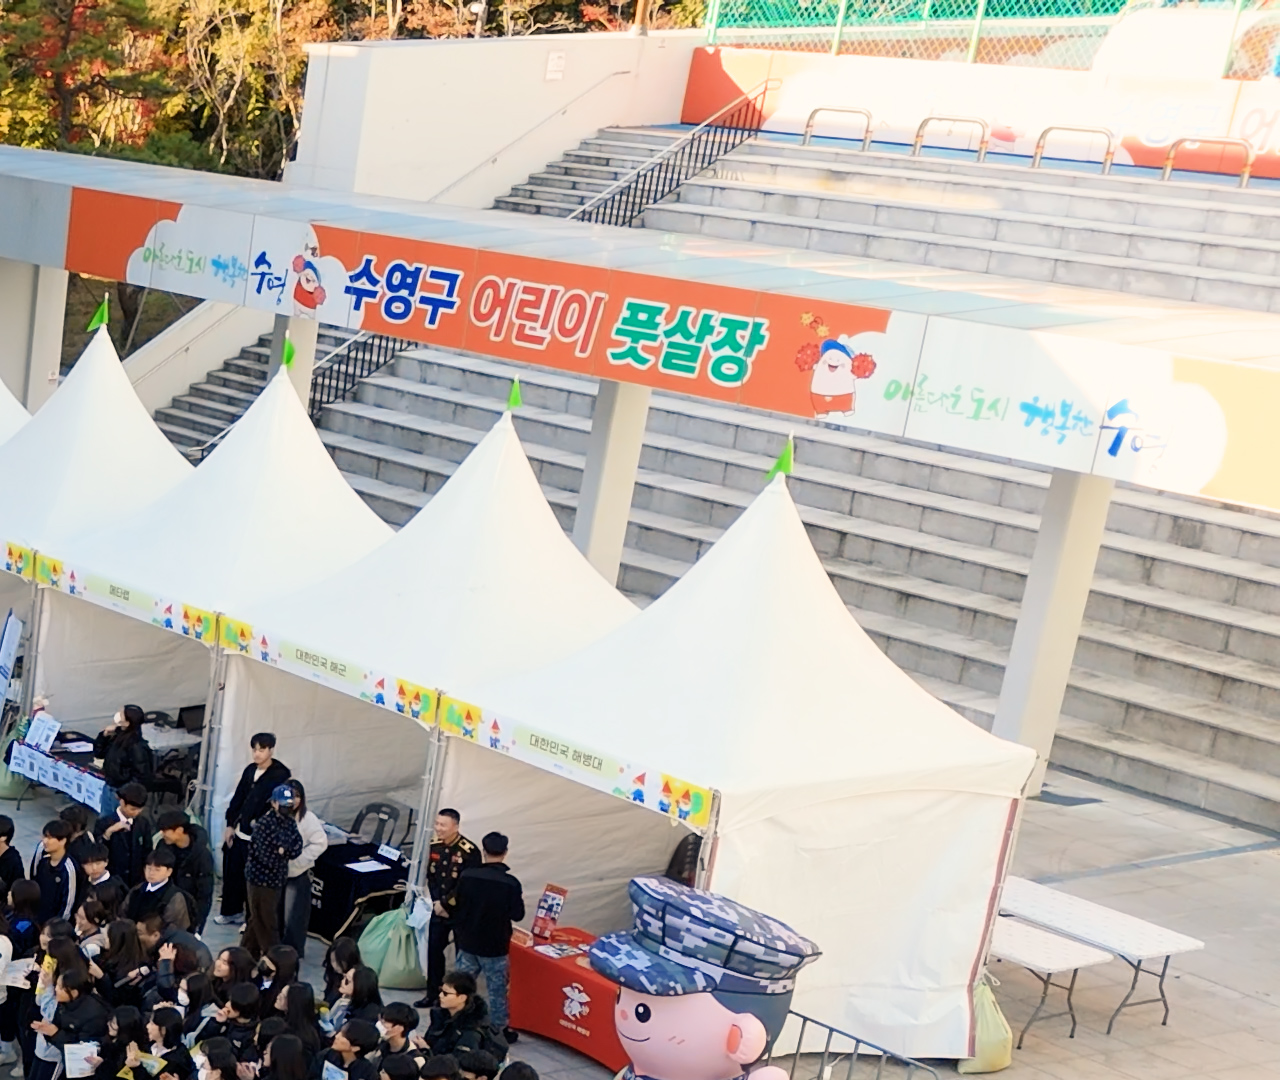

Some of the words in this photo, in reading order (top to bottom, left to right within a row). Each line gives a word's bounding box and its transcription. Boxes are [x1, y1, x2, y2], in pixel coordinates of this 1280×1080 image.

[142, 246, 185, 273] 아름다운
[186, 249, 208, 276] 도시
[211, 254, 247, 288] 행복한
[250, 251, 288, 305] 수영
[344, 256, 462, 328] 수영구
[470, 275, 608, 357] 어린이
[607, 296, 768, 387] 풋살장
[883, 373, 965, 416] 아름다운
[966, 387, 1010, 421] 도시
[1019, 396, 1094, 444] 행복한
[295, 648, 328, 670] 대한민국
[329, 661, 347, 678] 해군
[529, 733, 570, 759] 대한민국
[571, 749, 604, 772] 해병대
